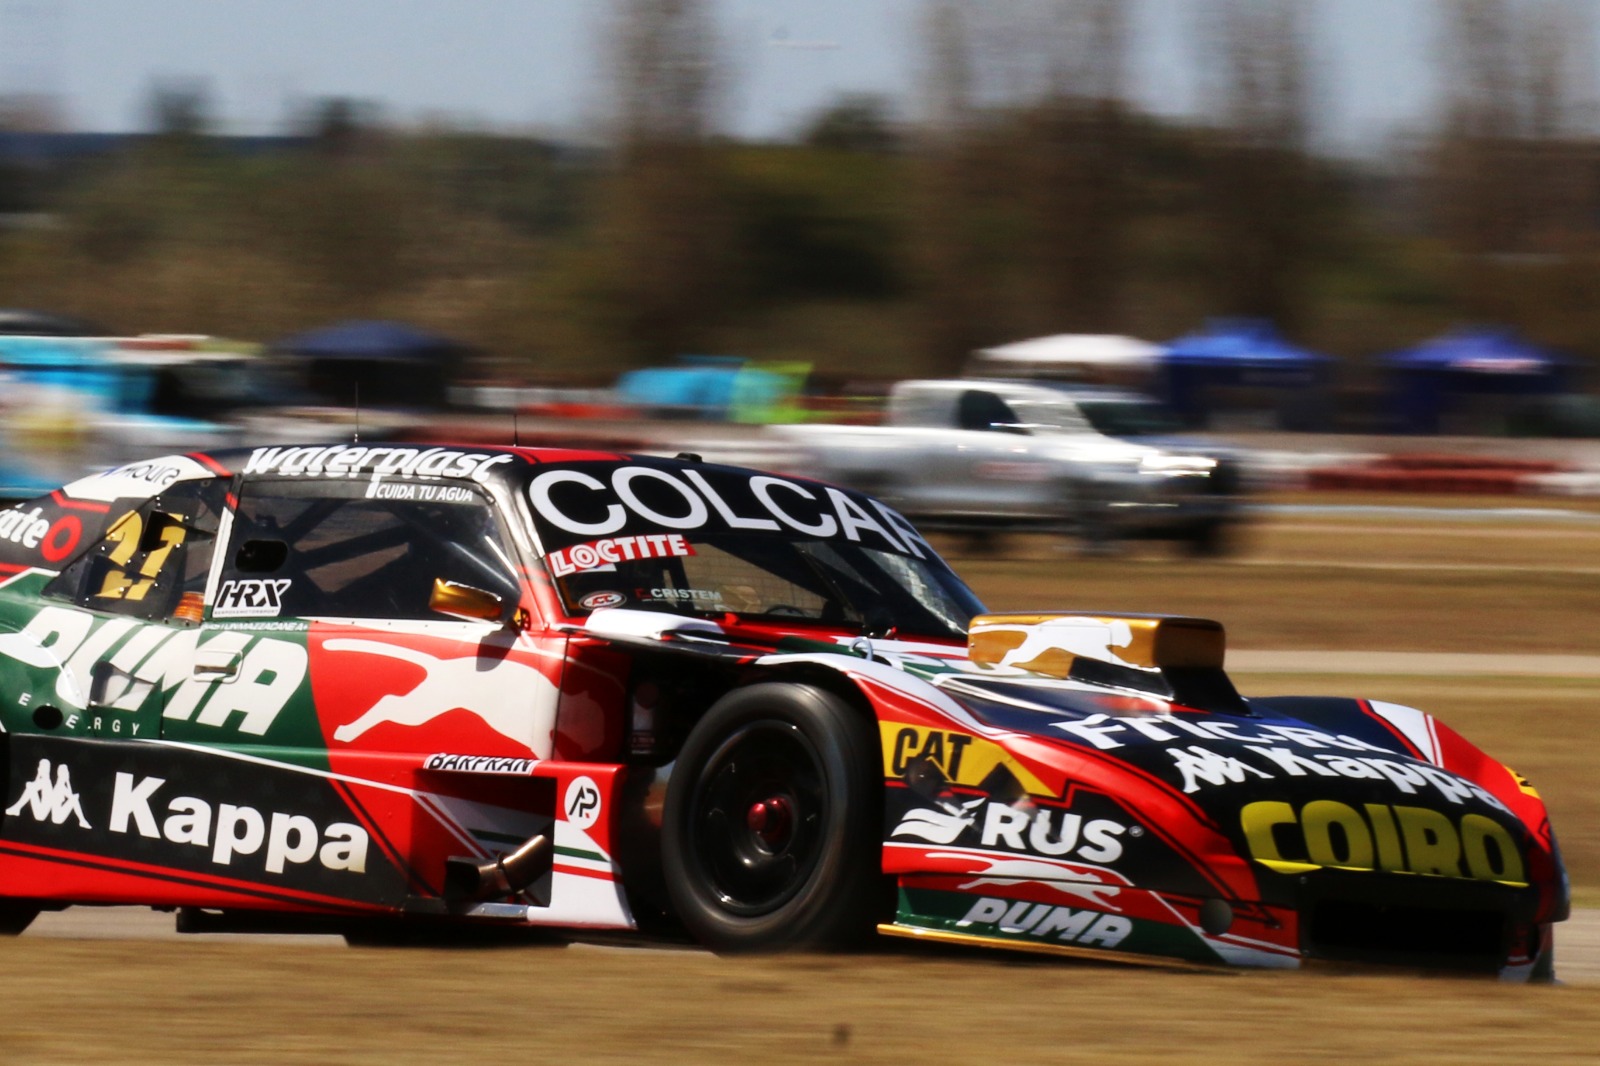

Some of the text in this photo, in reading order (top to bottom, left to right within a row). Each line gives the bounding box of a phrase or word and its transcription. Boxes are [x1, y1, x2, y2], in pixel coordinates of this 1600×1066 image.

[243, 445, 513, 498] waterplast
[376, 486, 473, 501] CUIDA TU AGUA
[530, 466, 928, 560] COLCAR
[549, 534, 688, 578] LOCTITE
[216, 583, 288, 608] HRX
[651, 588, 722, 601] CRISTEM
[0, 606, 308, 736] PUMA
[18, 692, 140, 736] EERGY
[892, 728, 972, 779] CAT
[1244, 744, 1516, 817] Kappa
[109, 771, 370, 874] Kappa
[981, 802, 1127, 864] RUS
[1240, 800, 1529, 888] COIRO
[957, 897, 1133, 949] PUMA
